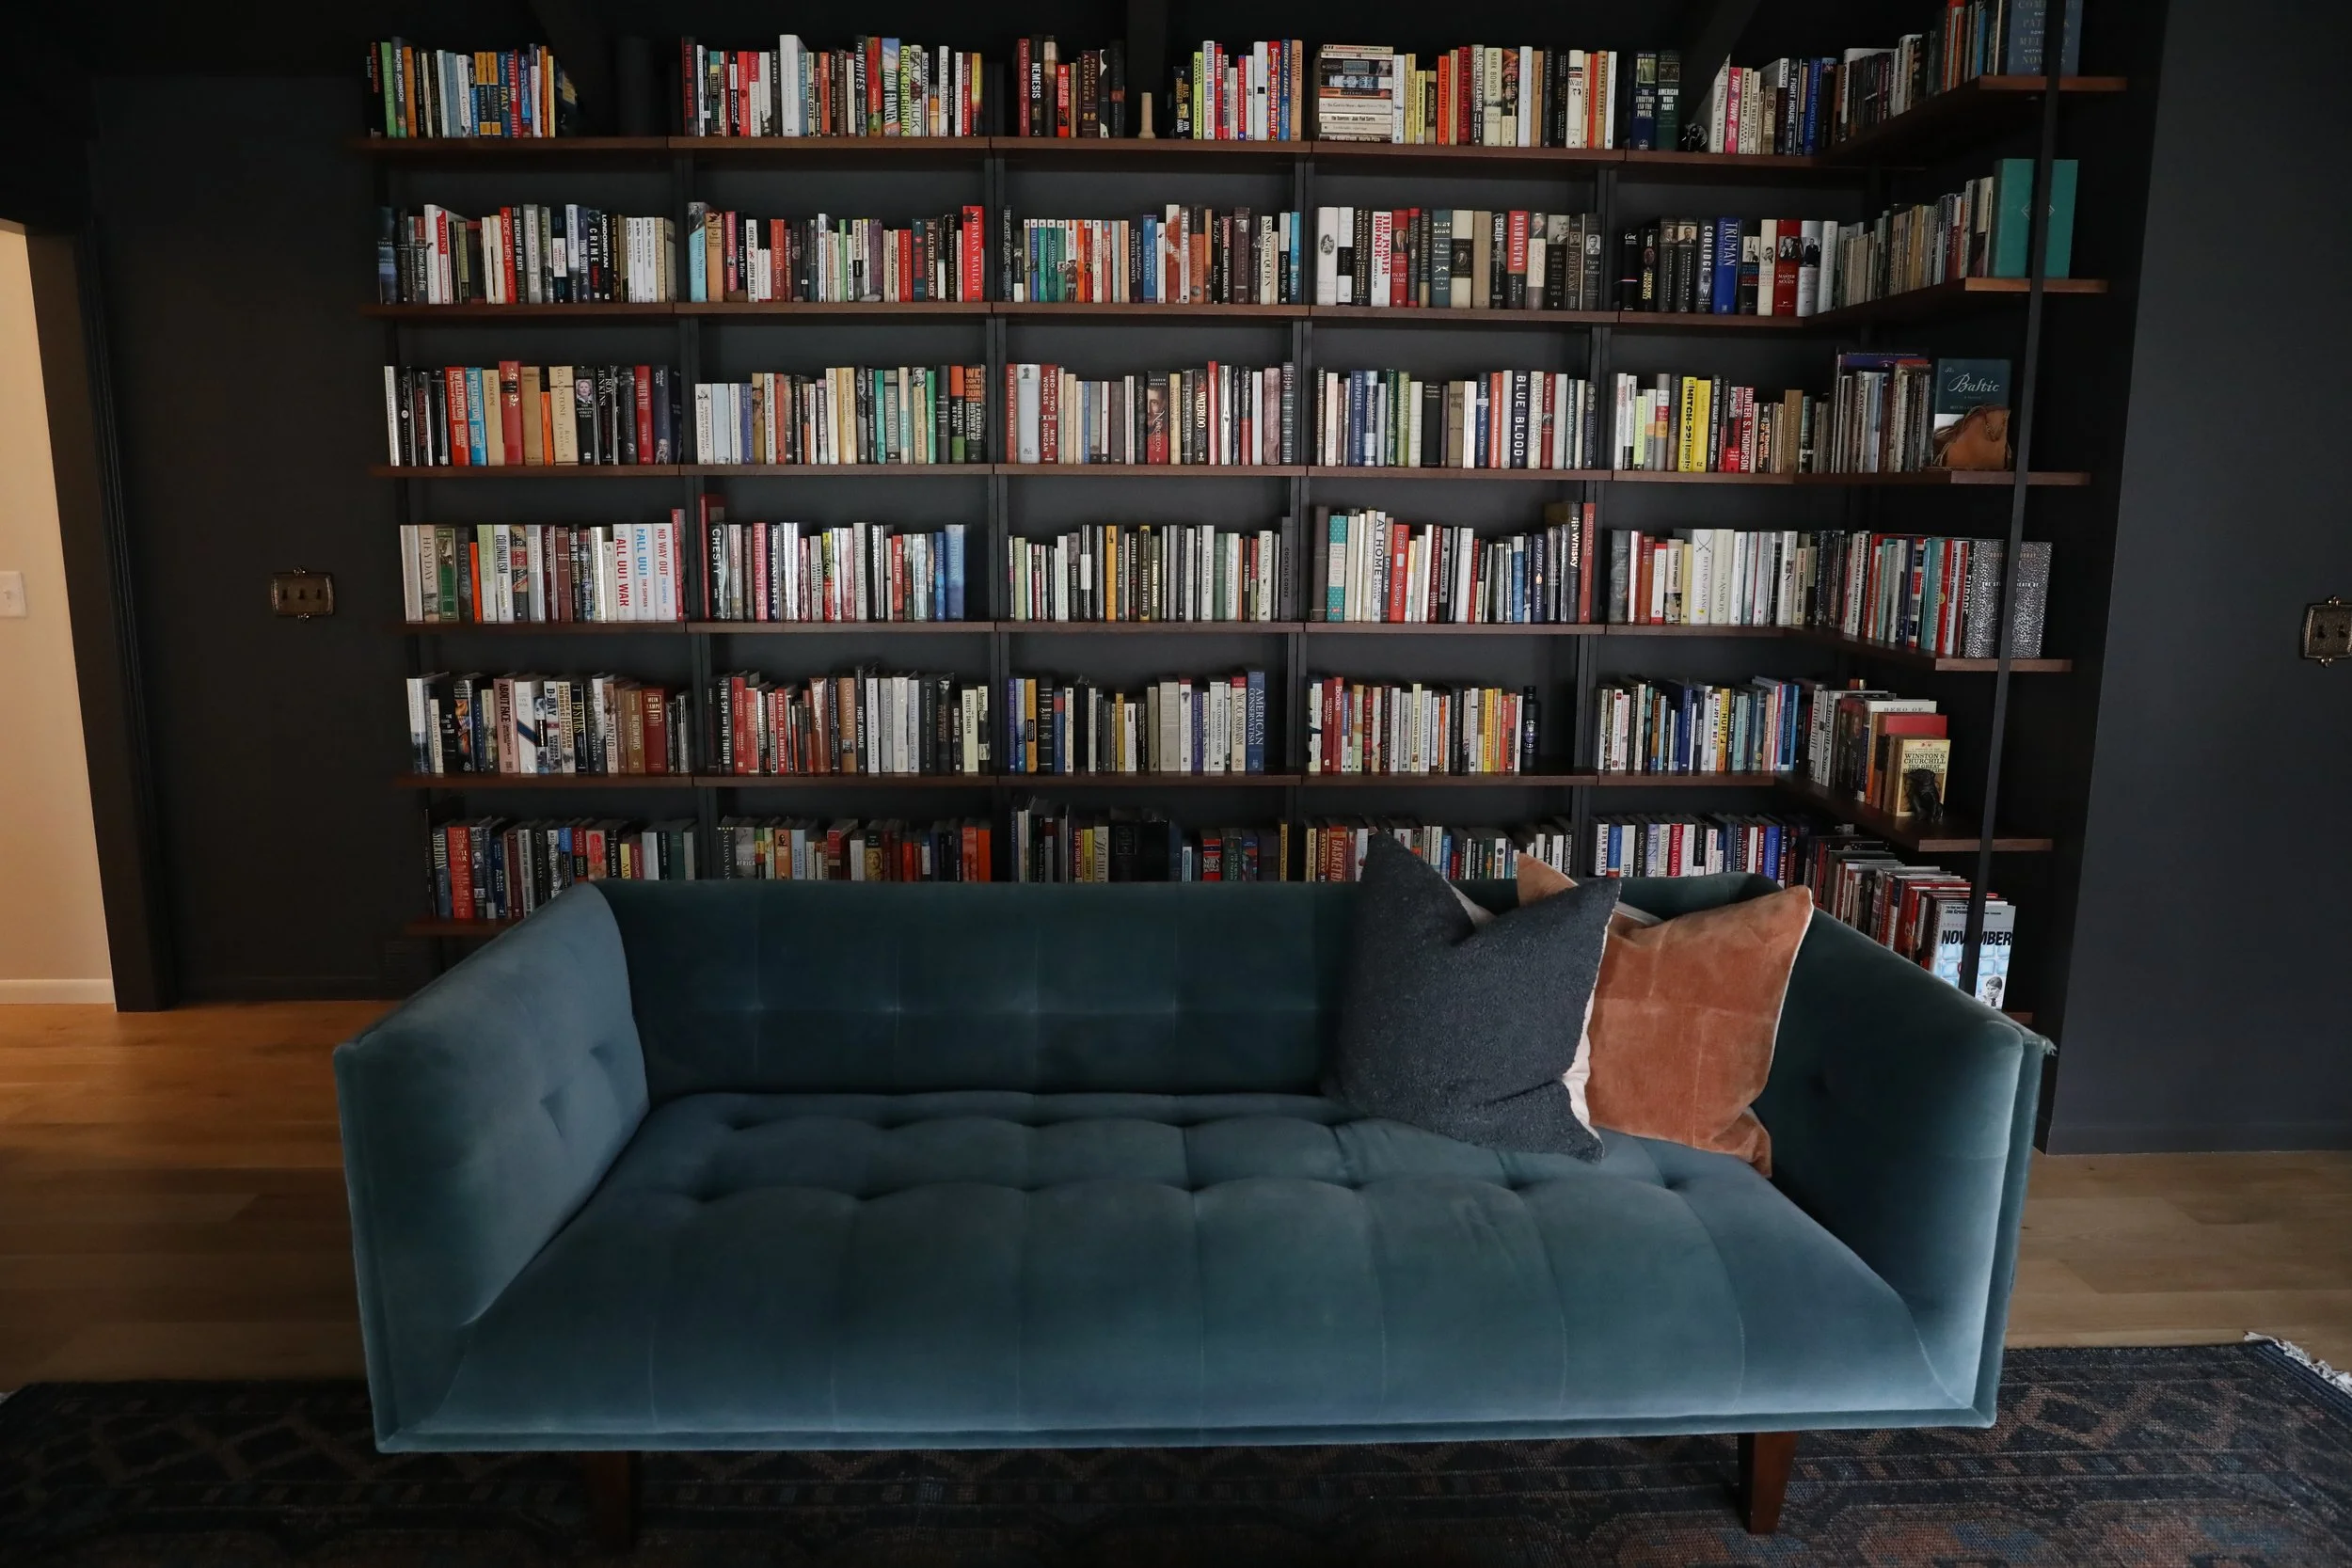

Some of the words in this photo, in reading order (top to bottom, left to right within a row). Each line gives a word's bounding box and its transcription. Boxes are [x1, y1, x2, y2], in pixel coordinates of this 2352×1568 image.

[856, 54, 865, 90] WHITES
[900, 49, 909, 77] CHUCK
[1032, 63, 1041, 98] NEMESIS
[911, 52, 920, 128] PALAHNIUK
[884, 93, 897, 124] FRANZEN
[1730, 99, 1739, 121] TOWN
[590, 228, 599, 261] CRIME
[1495, 218, 1503, 241] SCALIA
[1514, 215, 1525, 266] WASHINGTON
[1724, 222, 1738, 266] TRUMAN
[1703, 226, 1712, 272] COOLIDGE
[454, 372, 465, 419] WELLINGTON
[471, 372, 480, 419] WELLINGTON
[557, 369, 565, 419] GLADSTONE
[597, 369, 606, 406] JENKINS
[1516, 375, 1526, 407] BLUE
[1947, 372, 2000, 393] Baltic
[887, 393, 896, 419] MICHAEL
[1197, 391, 1206, 428] WATERLOO
[1743, 388, 1754, 418] HUNTER
[888, 419, 897, 447] COLLINS
[1514, 416, 1525, 456] BLOOD
[1740, 429, 1751, 469] THOMPSON
[657, 529, 666, 540] NO
[1376, 519, 1385, 536] AT
[422, 537, 433, 580] HEYDAY
[495, 535, 508, 574] COLONIALISM
[659, 542, 667, 559] WAY
[712, 529, 722, 575] CHESTY
[1375, 540, 1384, 576] HOME
[1569, 532, 1580, 567] Whisky
[659, 561, 668, 576] OUT
[1718, 581, 1726, 613] ANARCHY
[499, 684, 509, 705] ABOUT
[547, 689, 556, 716] D-DAY
[501, 706, 511, 722] FACE
[1255, 688, 1263, 745] AMERICAN
[1810, 702, 1820, 749] Churchill
[606, 722, 614, 746] ANZIO
[433, 833, 447, 870] SHERIDAN
[1942, 930, 2013, 945] NOVBER
